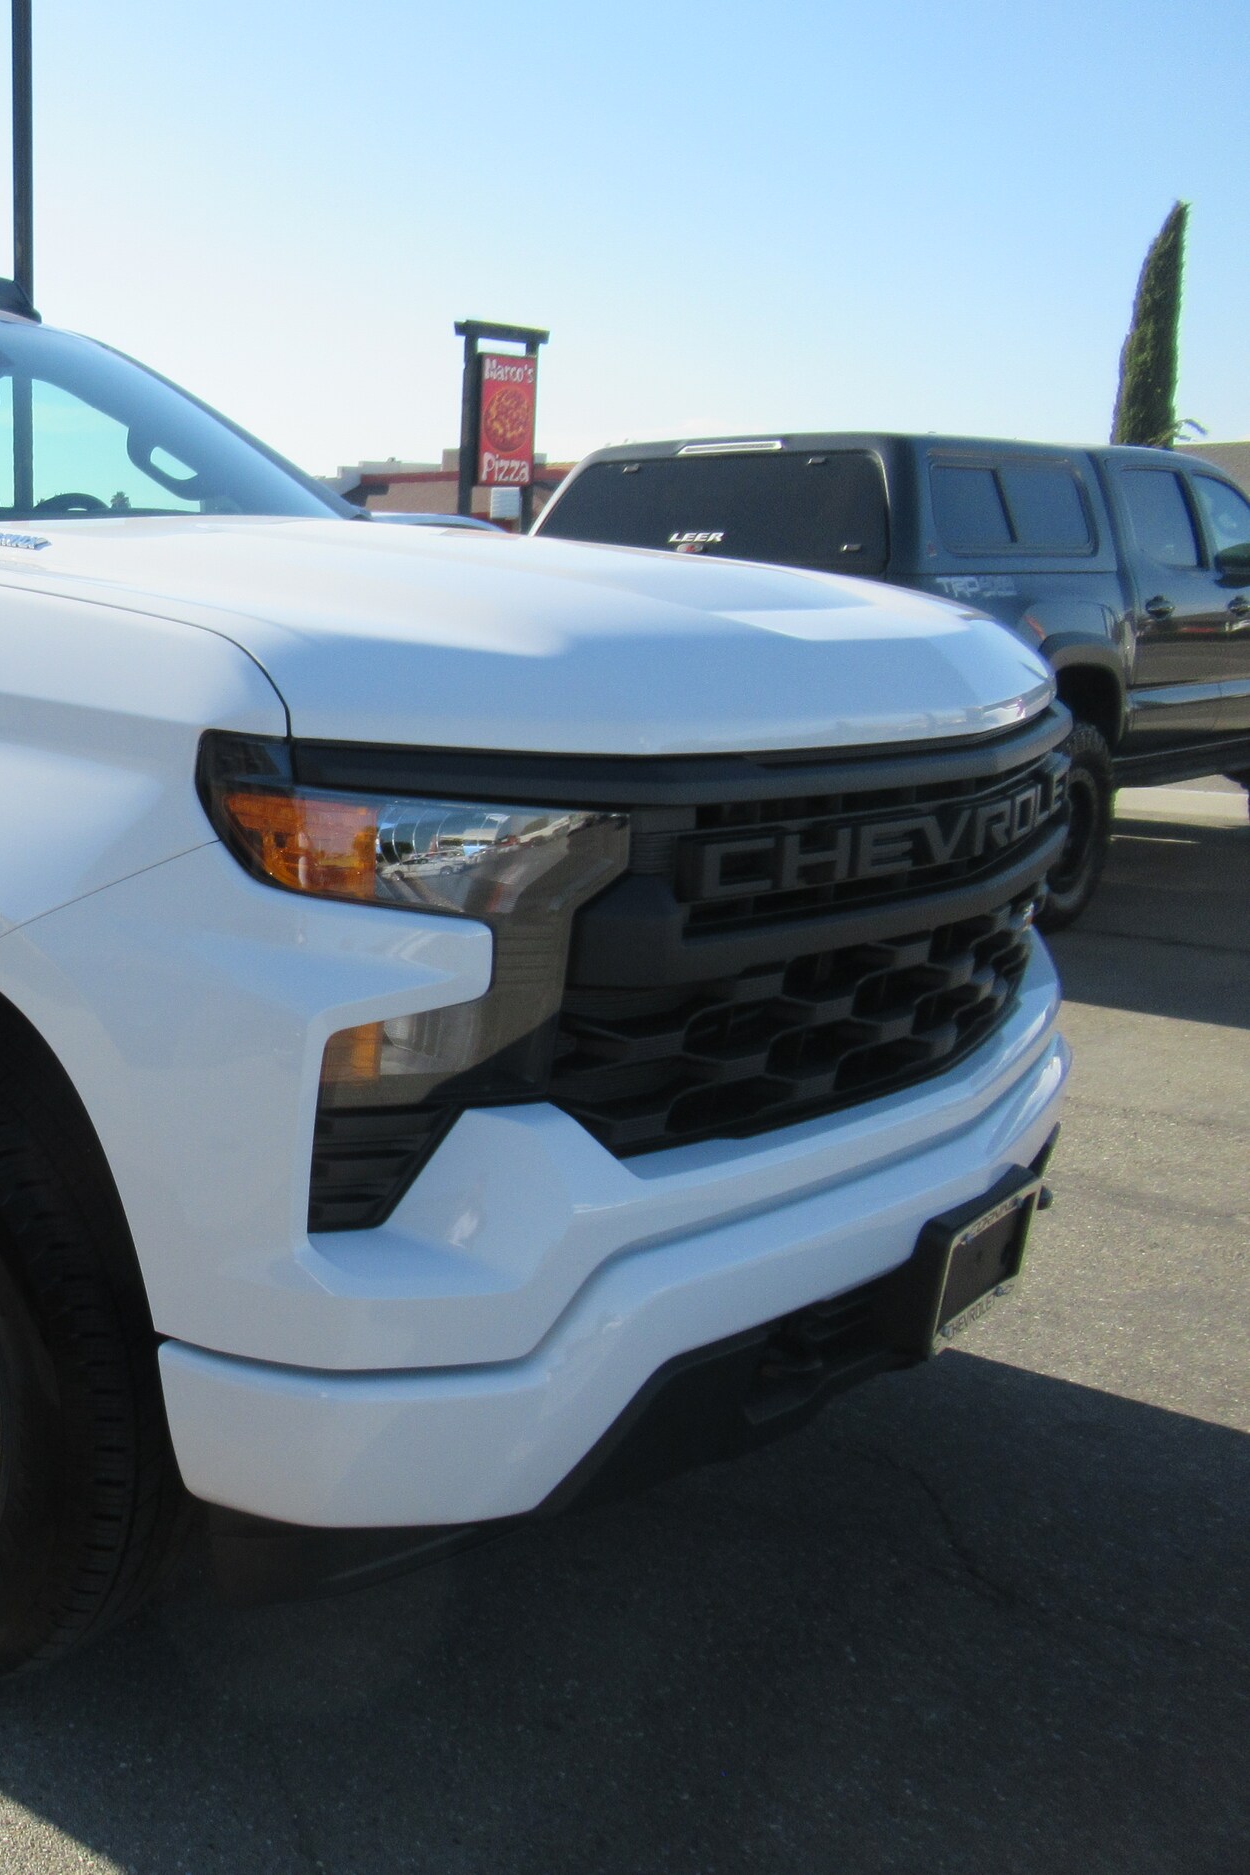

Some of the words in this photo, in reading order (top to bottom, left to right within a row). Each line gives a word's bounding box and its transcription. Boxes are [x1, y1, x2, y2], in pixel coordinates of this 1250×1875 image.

[481, 452, 530, 482] Pizza
[668, 531, 725, 543] LEER
[702, 773, 1066, 899] CHEVROLE
